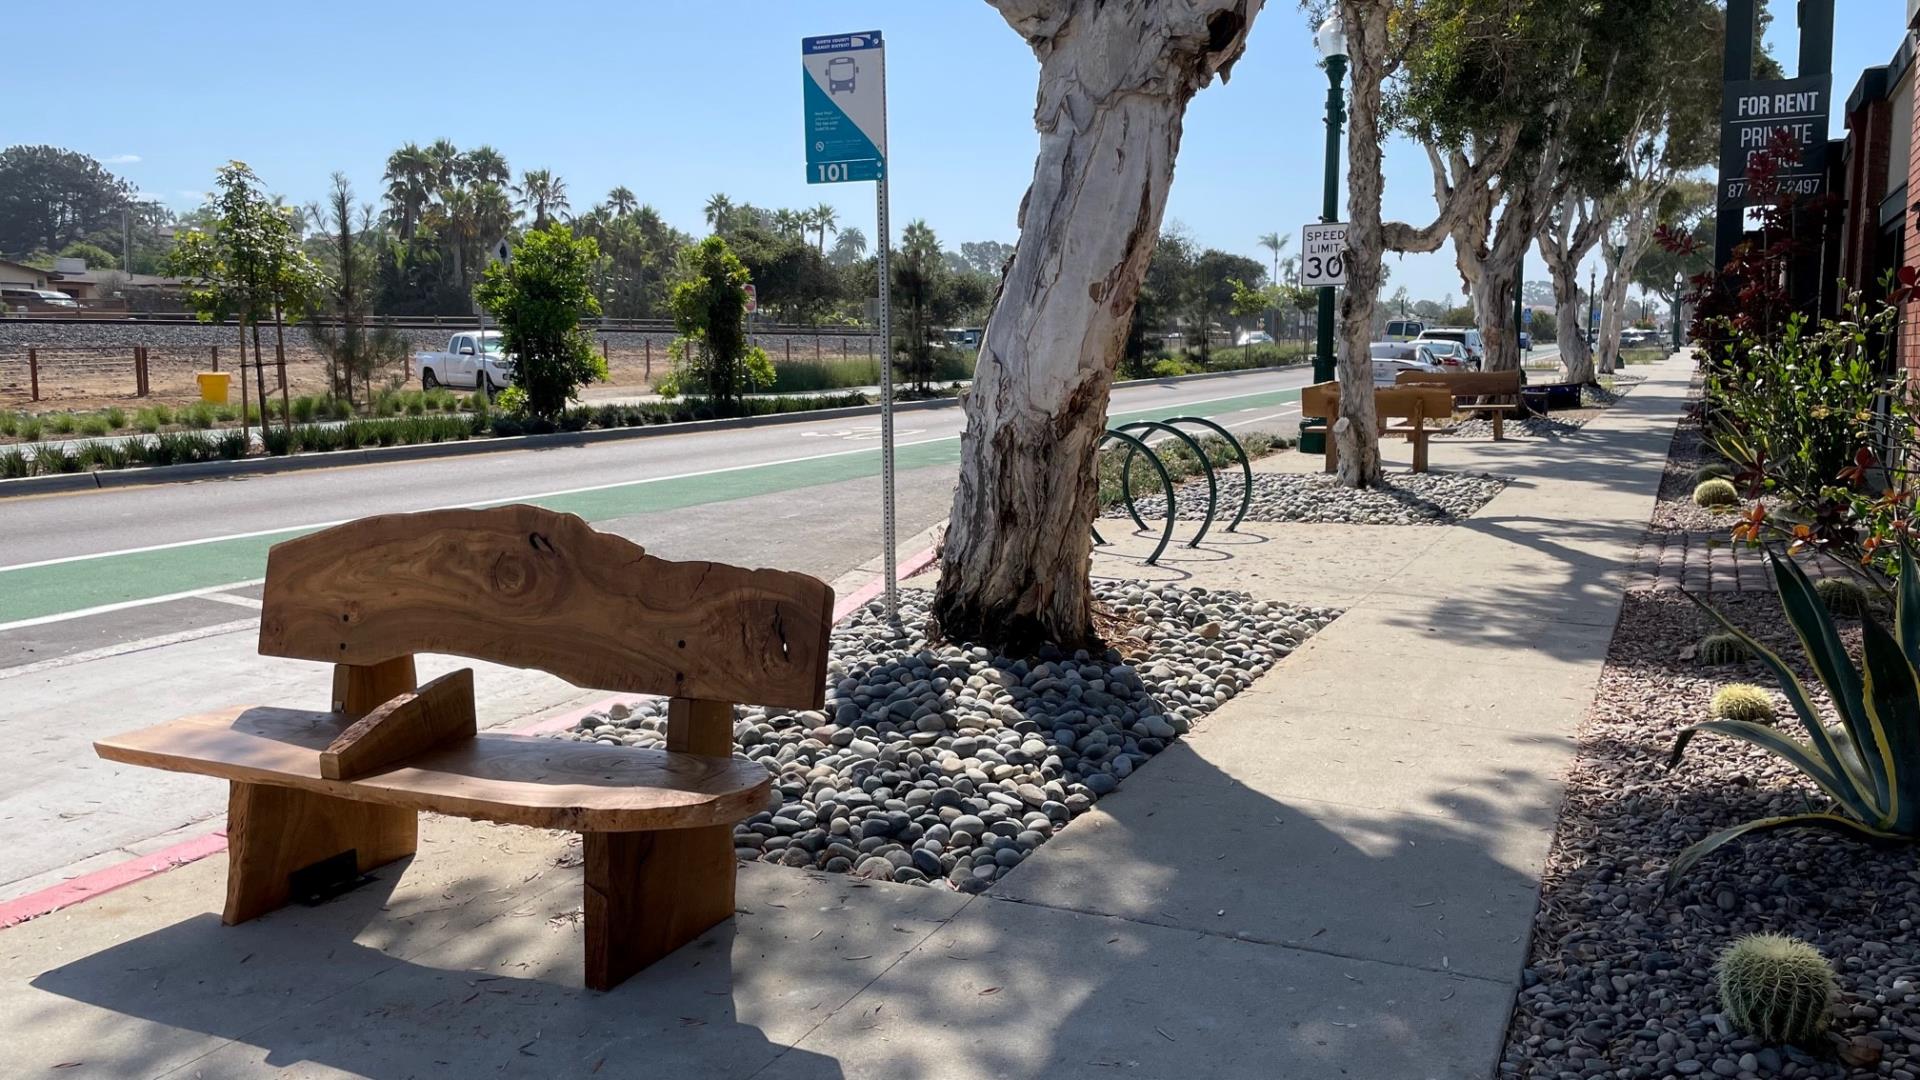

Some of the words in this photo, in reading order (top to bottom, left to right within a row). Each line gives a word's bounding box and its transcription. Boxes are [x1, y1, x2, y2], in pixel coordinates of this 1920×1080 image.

[1738, 95, 1770, 116] FOR
[1774, 91, 1819, 114] RENT
[818, 163, 848, 182] 101
[1306, 230, 1346, 241] SPEED
[1310, 243, 1340, 254] LIMIT
[1306, 256, 1343, 279] 30
